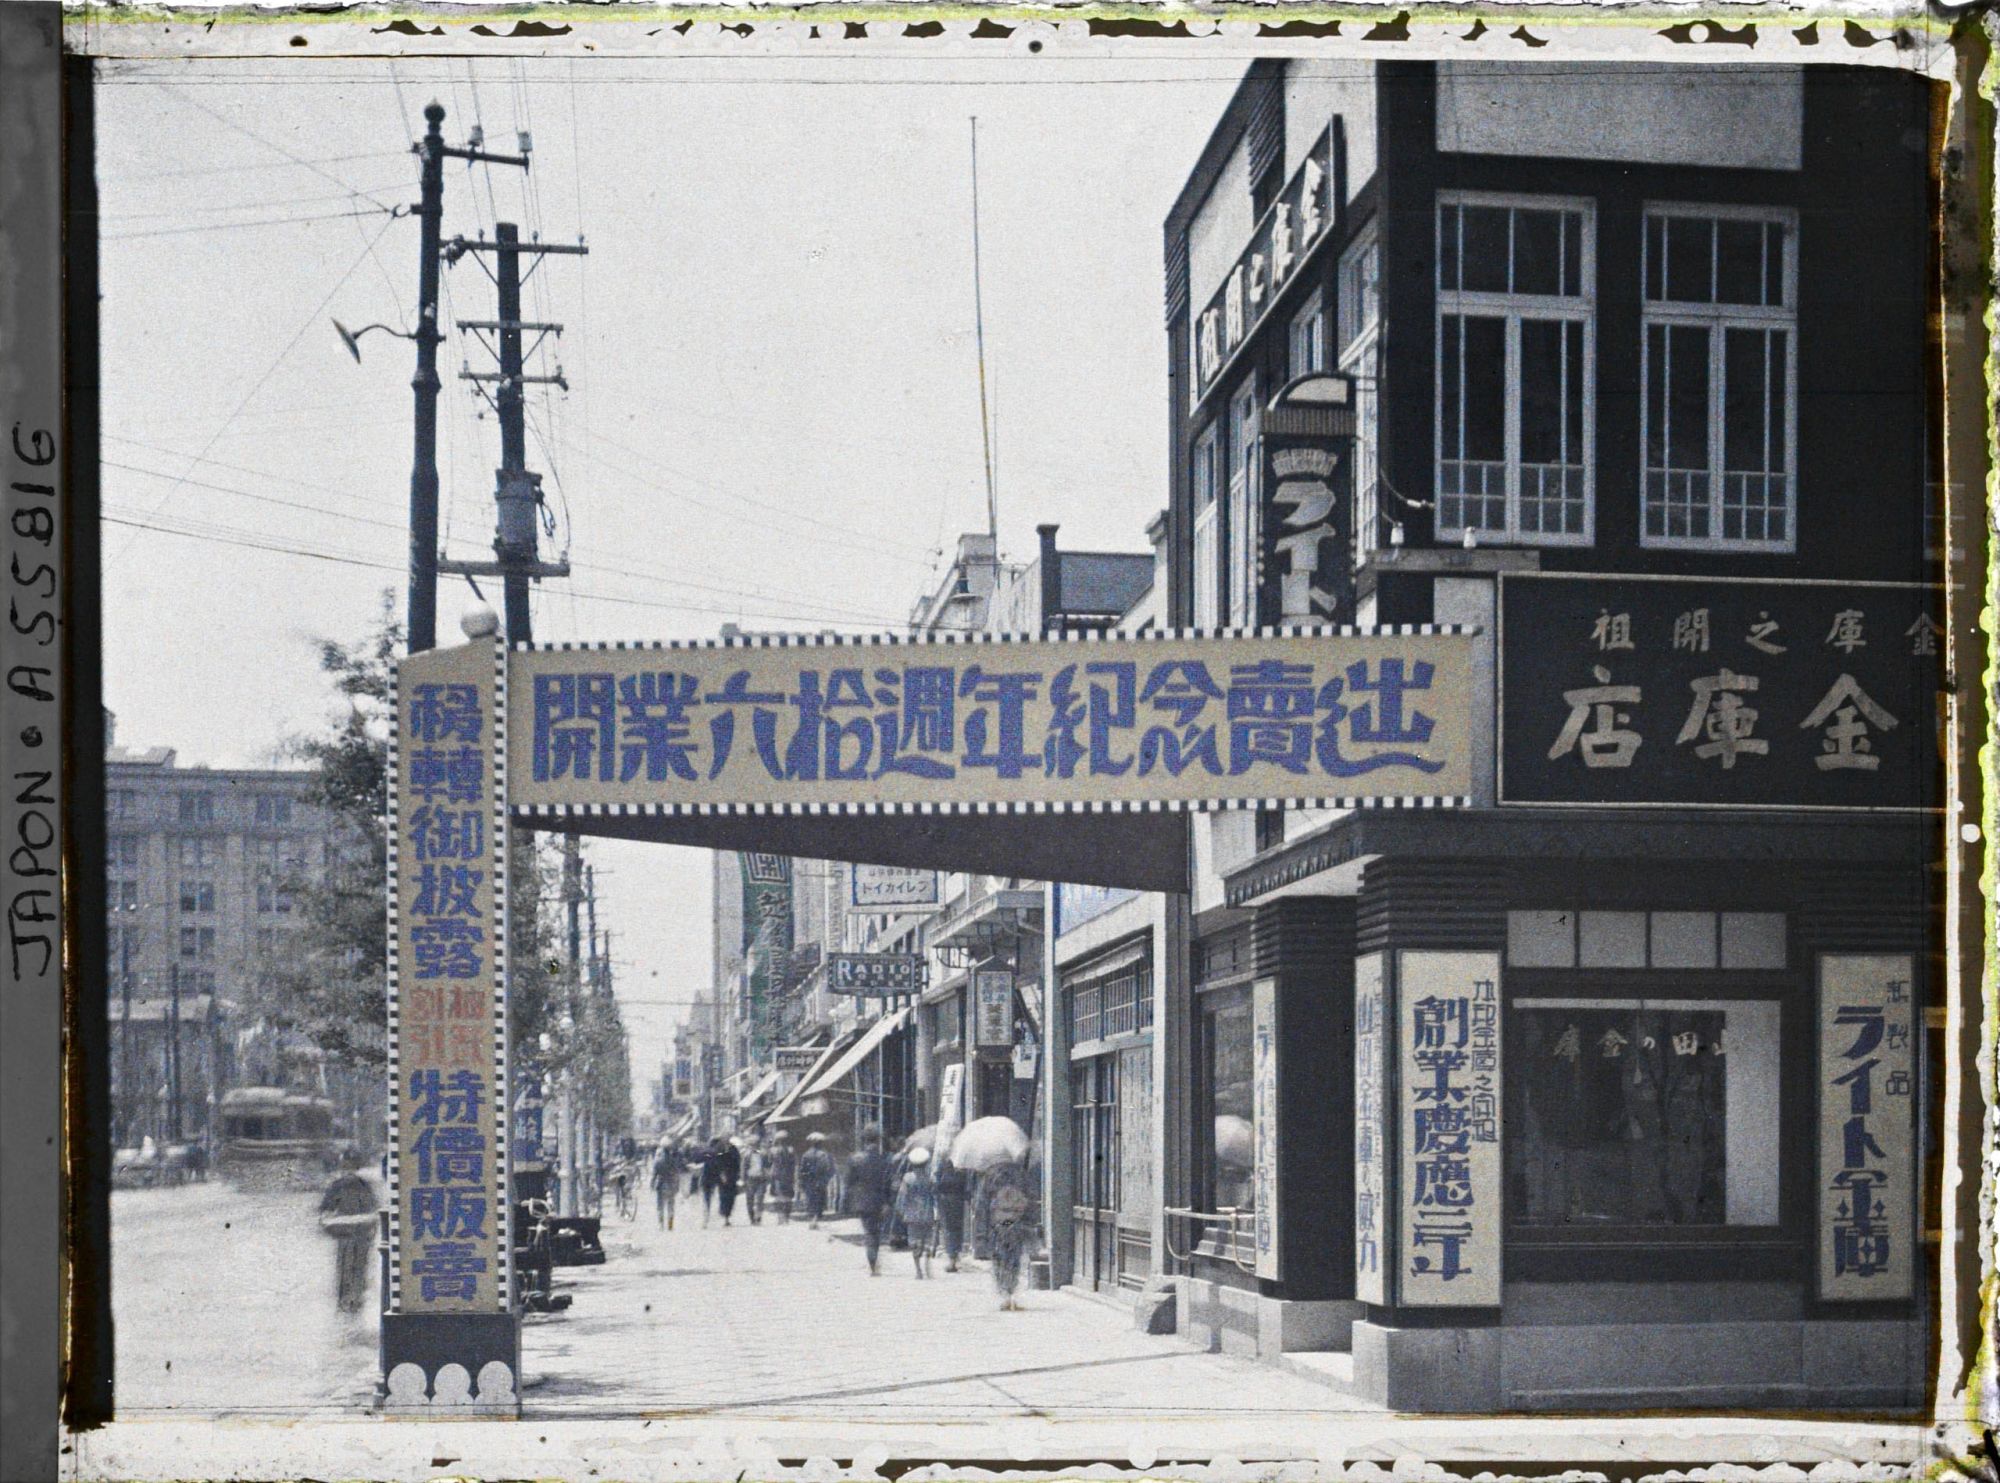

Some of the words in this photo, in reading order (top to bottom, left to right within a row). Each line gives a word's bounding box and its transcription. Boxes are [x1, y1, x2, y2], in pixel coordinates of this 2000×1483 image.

[1272, 480, 1337, 626] ライト
[7, 771, 55, 982] JAPON
[1829, 1005, 1890, 1278] ライト金庫
